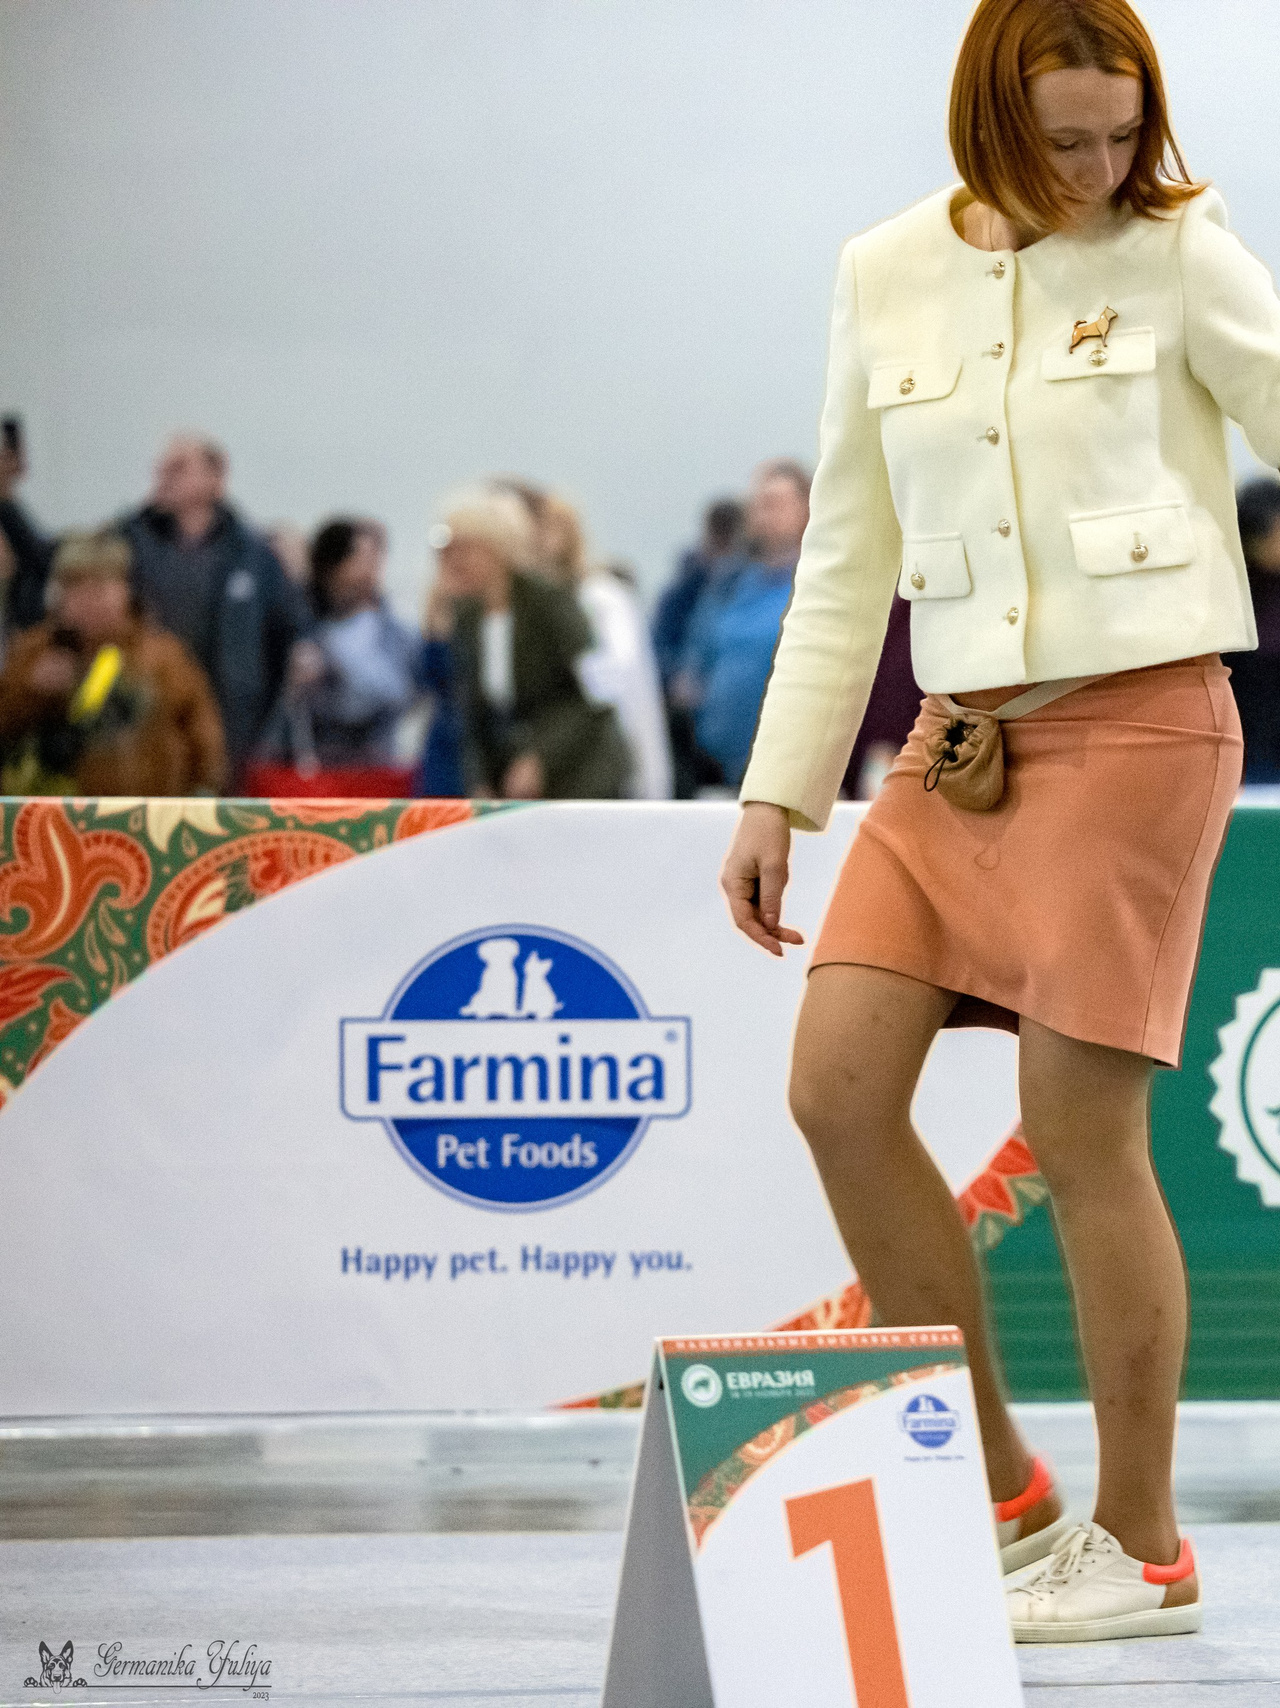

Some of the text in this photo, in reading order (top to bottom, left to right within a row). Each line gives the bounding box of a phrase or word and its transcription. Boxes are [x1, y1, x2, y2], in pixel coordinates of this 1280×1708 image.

[366, 1033, 666, 1104] Farmina
[436, 1133, 598, 1169] Pet Foods
[340, 1246, 438, 1281] Happy
[520, 1246, 616, 1279] Happy
[629, 1250, 693, 1279] you.
[725, 1368, 816, 1390] ЕВРАЗИЯ
[784, 1477, 910, 1708] 1
